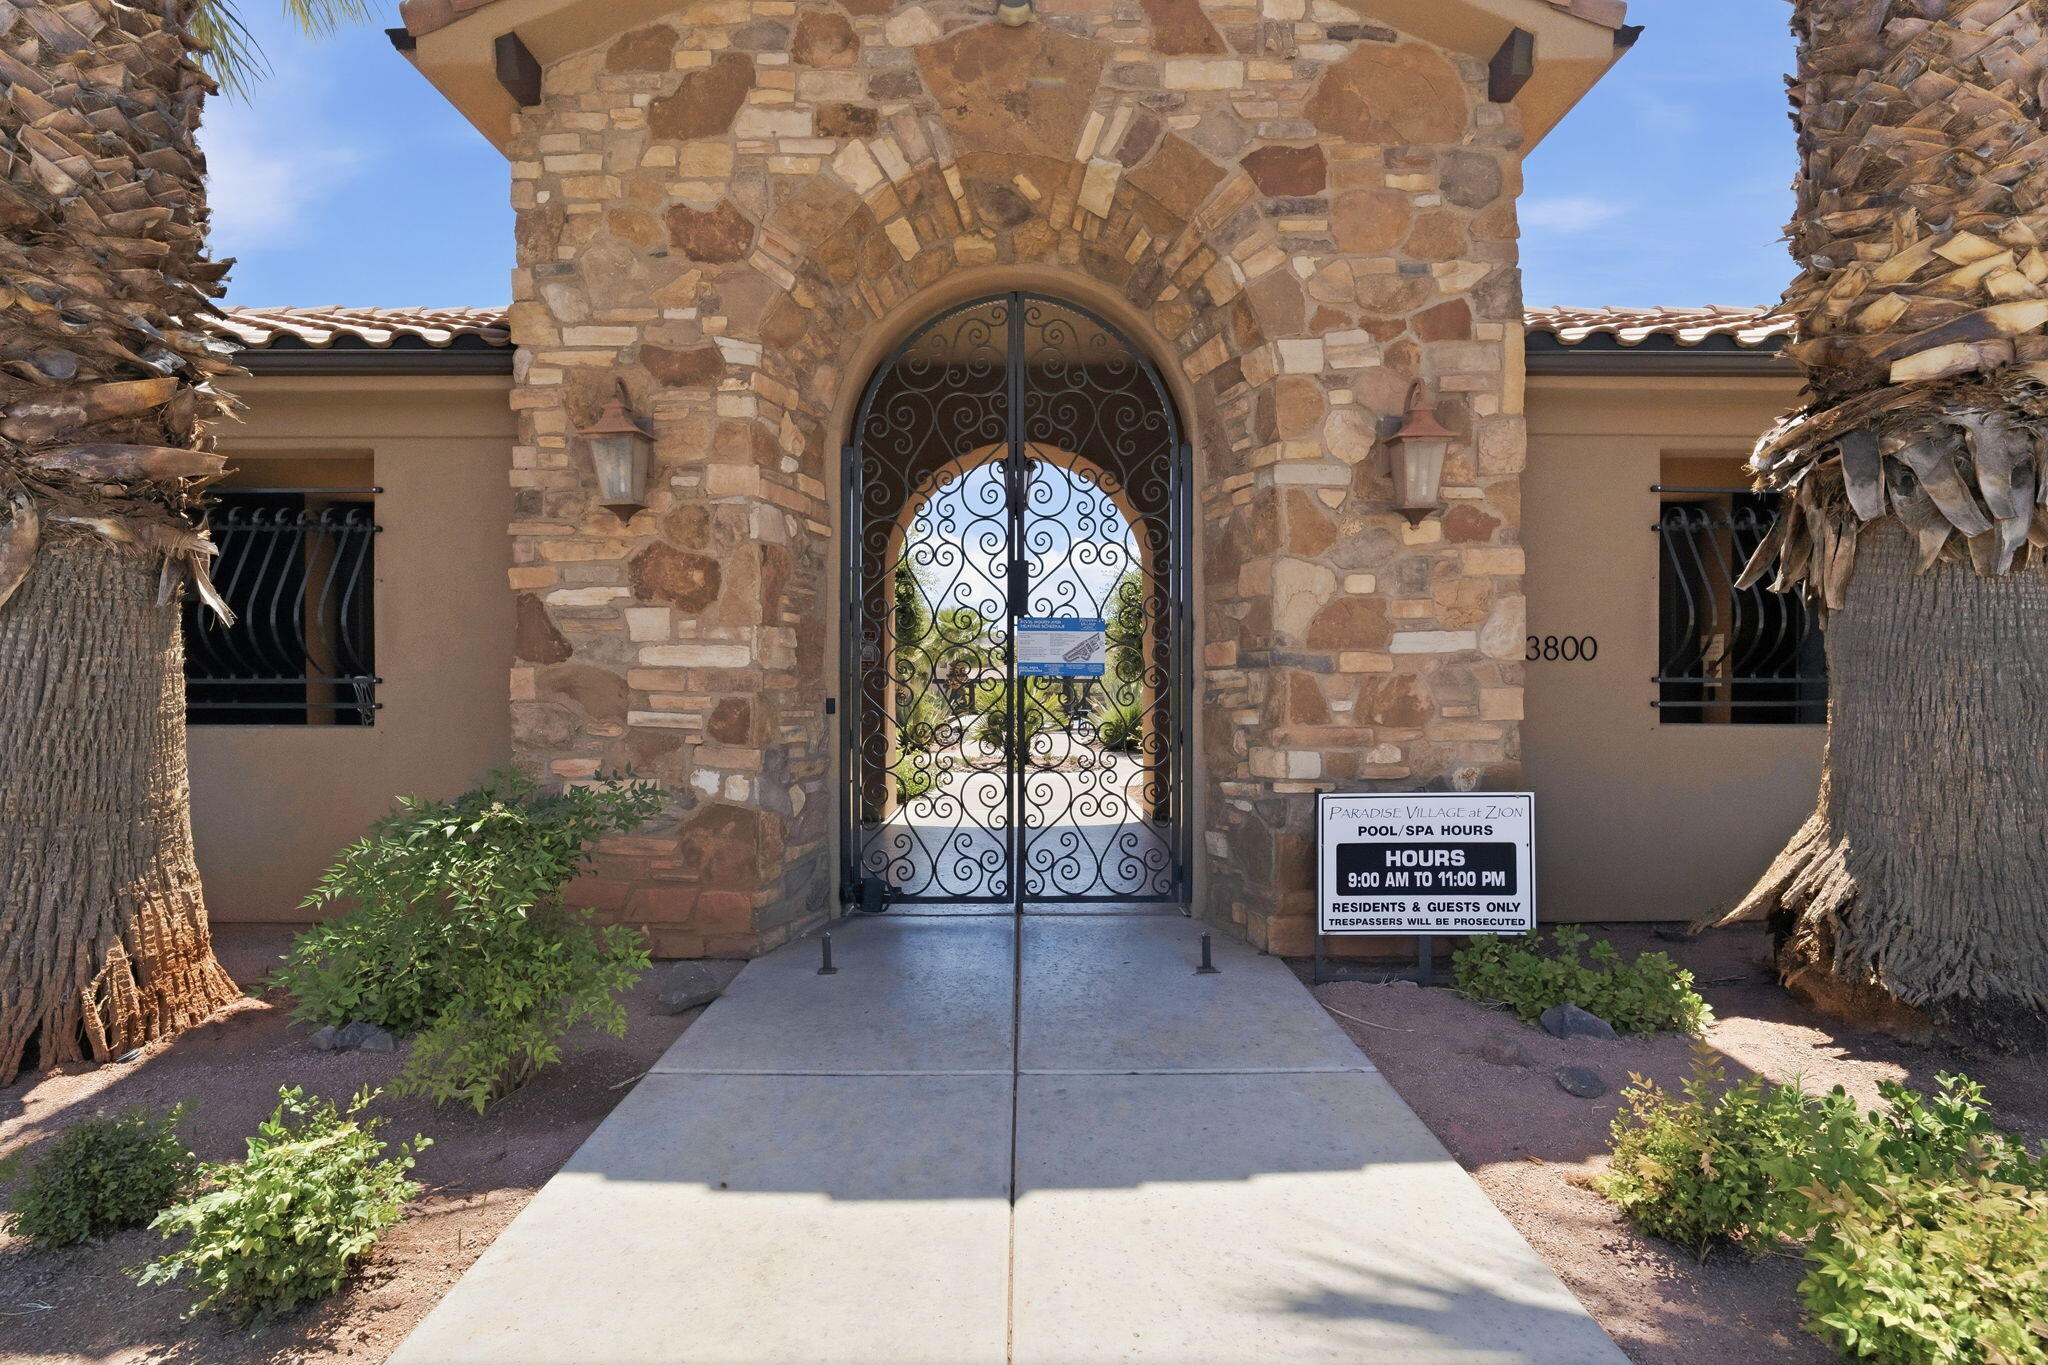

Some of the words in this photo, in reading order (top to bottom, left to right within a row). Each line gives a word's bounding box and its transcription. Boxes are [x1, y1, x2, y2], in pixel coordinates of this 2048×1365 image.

[1526, 636, 1597, 661] 3800
[1329, 806, 1402, 820] PARADISE
[1406, 806, 1467, 819] VILLAGE
[1468, 809, 1481, 818] at
[1485, 805, 1524, 819] ZION
[1358, 825, 1434, 837] POOL/SPA
[1441, 825, 1493, 836] HOURS
[1385, 849, 1466, 867] HOURS
[1348, 872, 1380, 888] 9:00
[1385, 872, 1409, 887] AM
[1414, 872, 1433, 887] TO
[1438, 871, 1476, 887] 11:00
[1481, 871, 1505, 886] PM
[1332, 902, 1406, 912] RESIDENTS
[1412, 902, 1421, 912] &
[1427, 902, 1480, 912] GUESTS
[1486, 902, 1521, 912] ONLY
[1329, 918, 1402, 926] TRESPASSERS
[1407, 918, 1431, 926] WILL
[1436, 918, 1450, 926] BE
[1454, 918, 1526, 926] PROSECUTED
